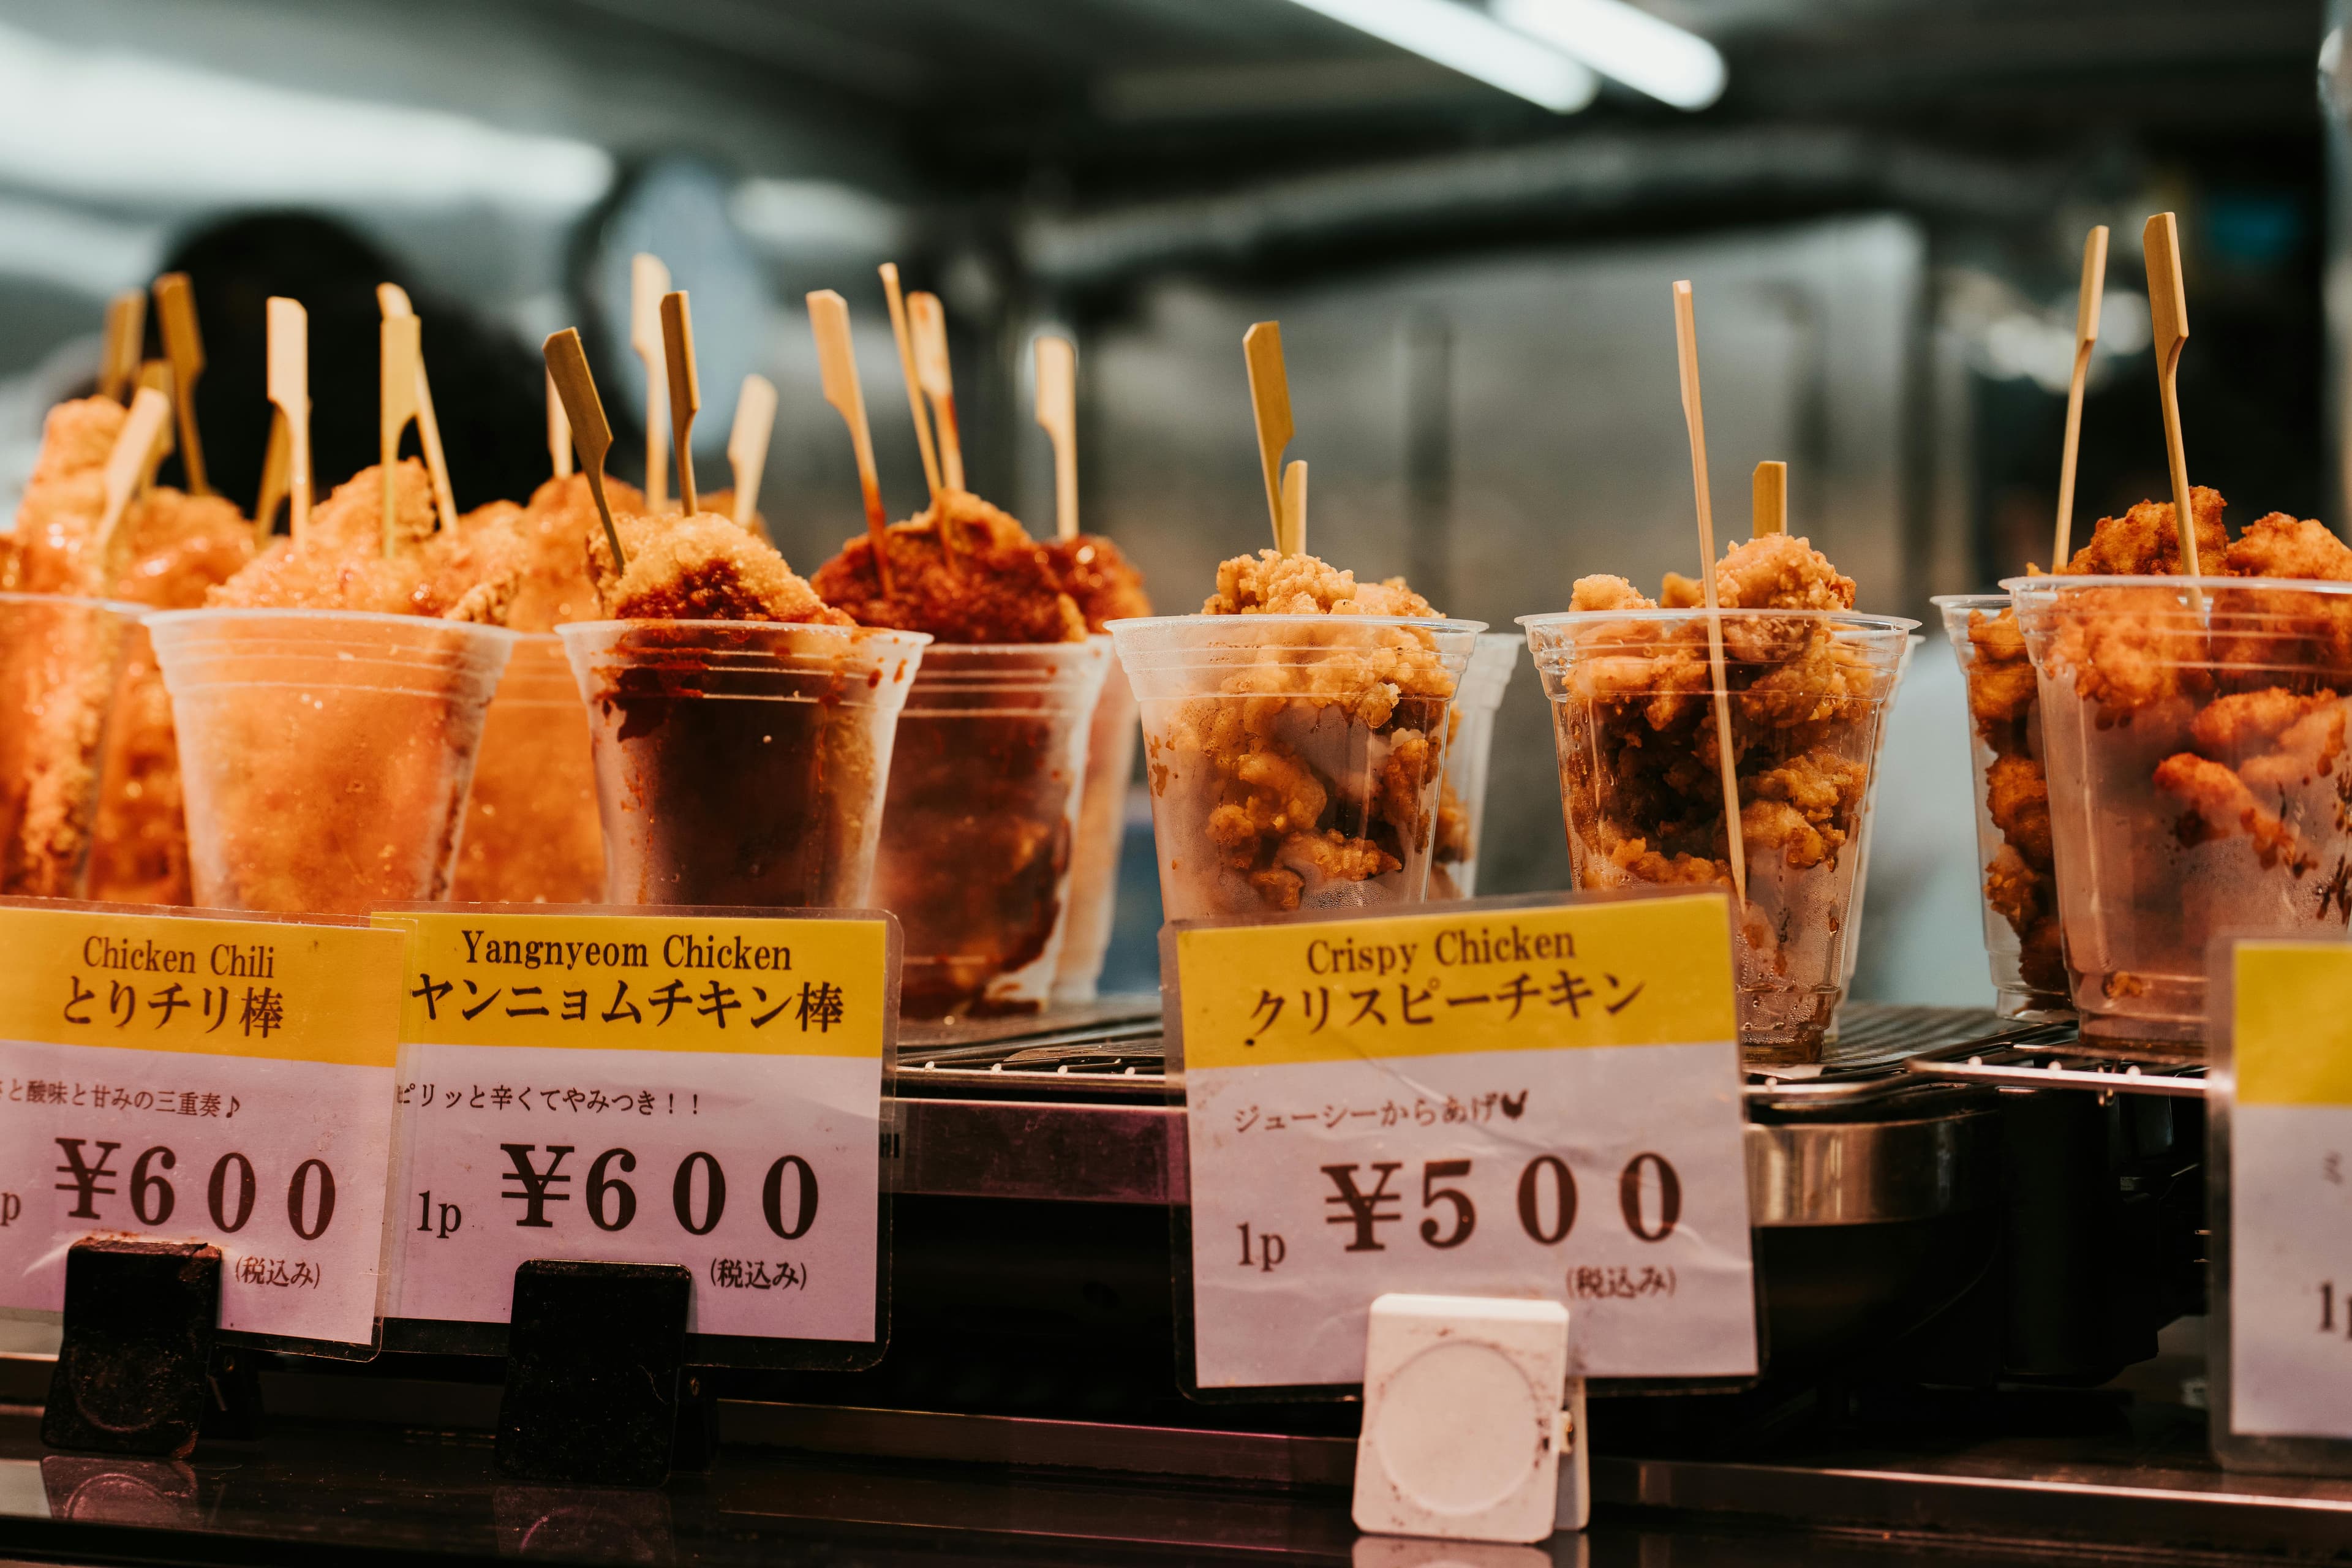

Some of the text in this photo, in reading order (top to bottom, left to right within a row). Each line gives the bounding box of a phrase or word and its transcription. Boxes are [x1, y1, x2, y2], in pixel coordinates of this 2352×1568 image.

[83, 936, 274, 979] Chicken Chili
[461, 930, 793, 971] Yangnyeom Chicken
[1307, 925, 1576, 976] Crispy Chicken
[63, 976, 284, 1039] とりチリ棒
[411, 973, 844, 1033] ヤンニョムチキン棒
[1253, 969, 1646, 1036] クリスピーチキン
[0, 1078, 221, 1118] と酸味と甘みの三重奏
[55, 1137, 336, 1241] ¥600
[417, 1143, 820, 1240] 1p ¥600
[1237, 1152, 1683, 1272] 1p ¥500
[235, 1257, 320, 1289] (税込み)
[710, 1257, 807, 1291] (税込み)
[1566, 1265, 1676, 1300] (税込み)
